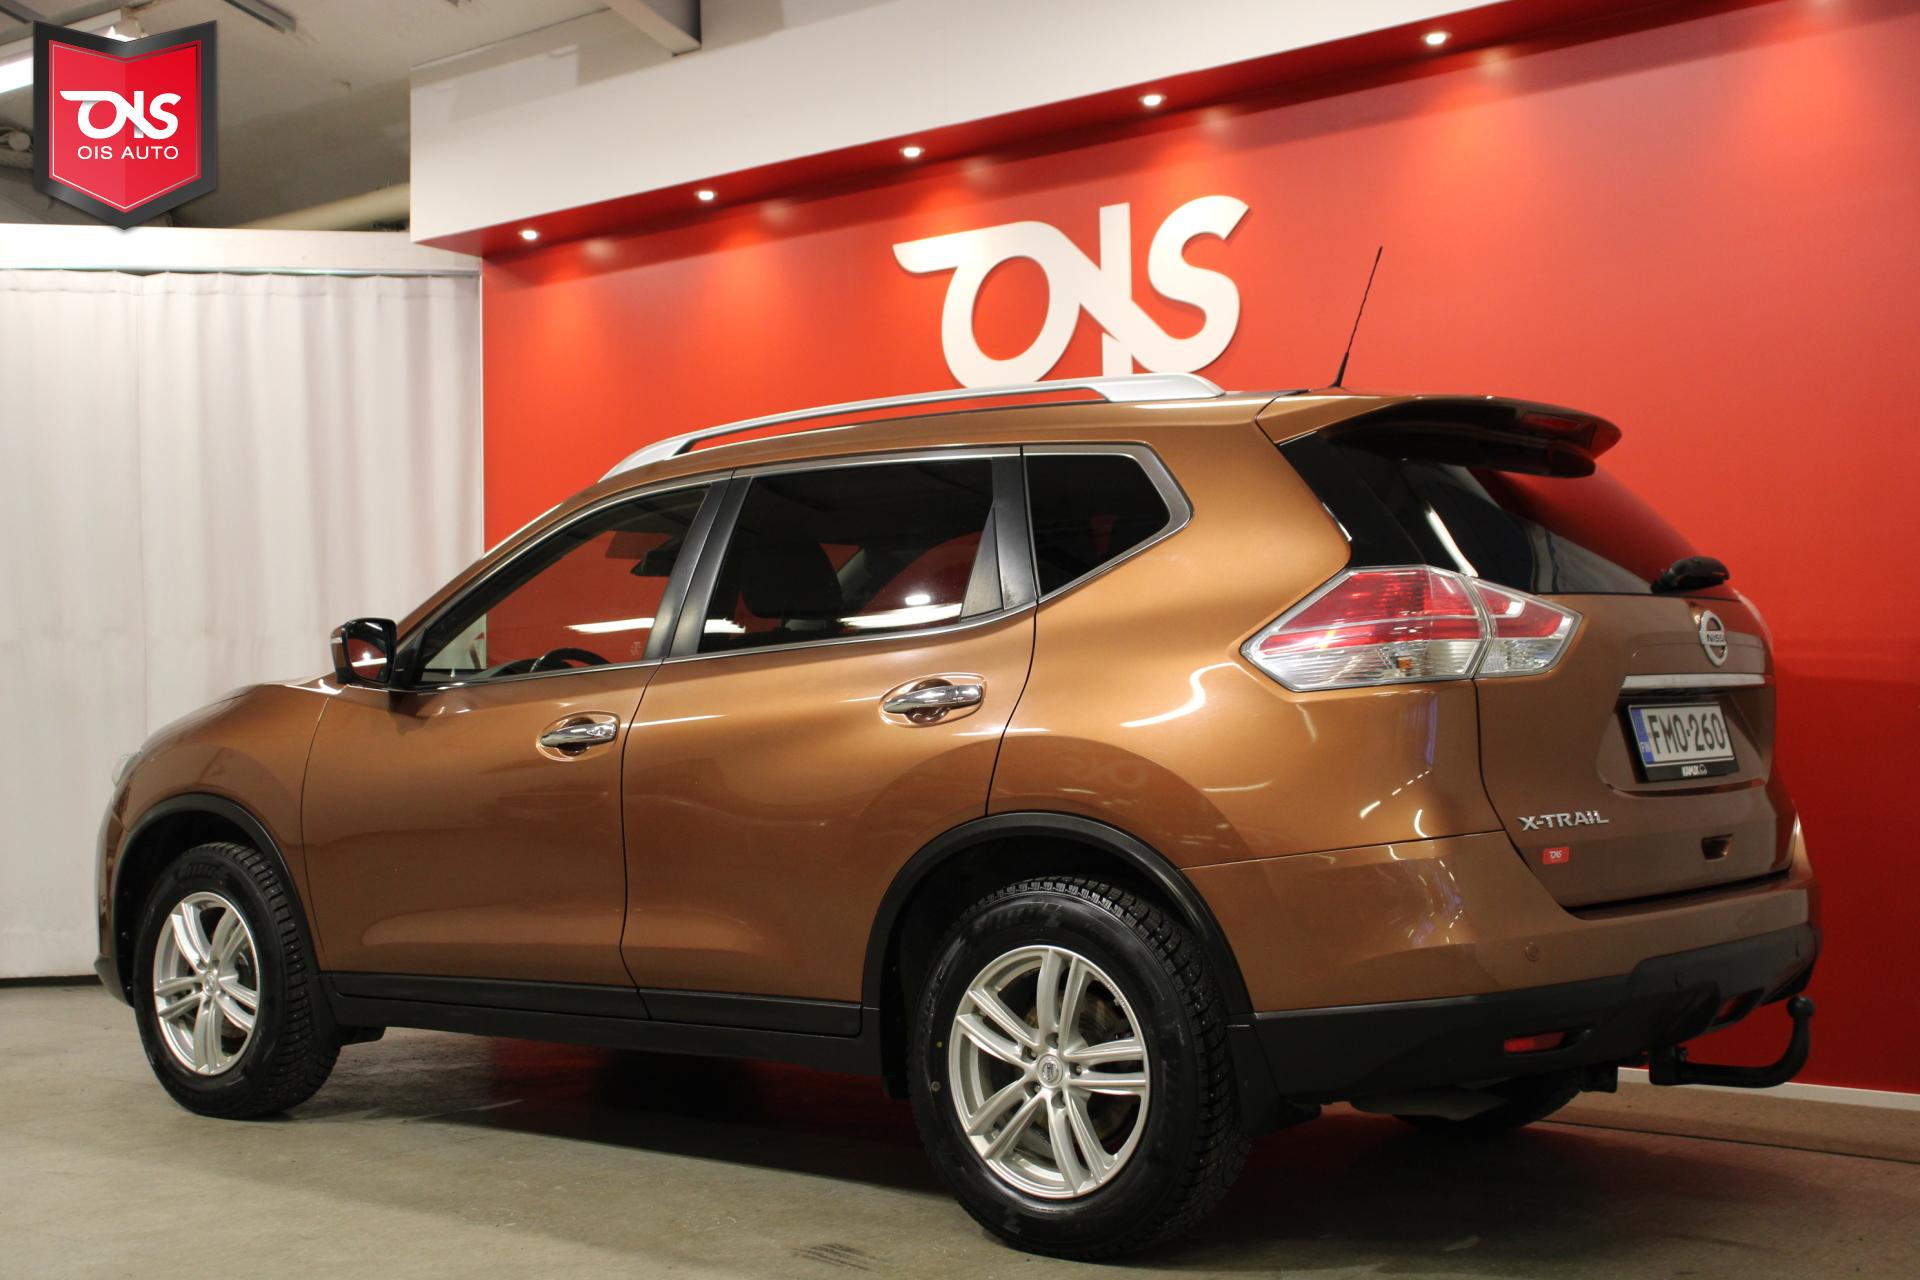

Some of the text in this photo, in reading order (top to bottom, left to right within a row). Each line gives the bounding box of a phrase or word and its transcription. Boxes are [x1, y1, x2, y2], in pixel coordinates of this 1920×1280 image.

[892, 195, 1249, 389] OIS
[1647, 712, 1726, 755] FMO-260
[1517, 810, 1610, 832] X-TRAIL
